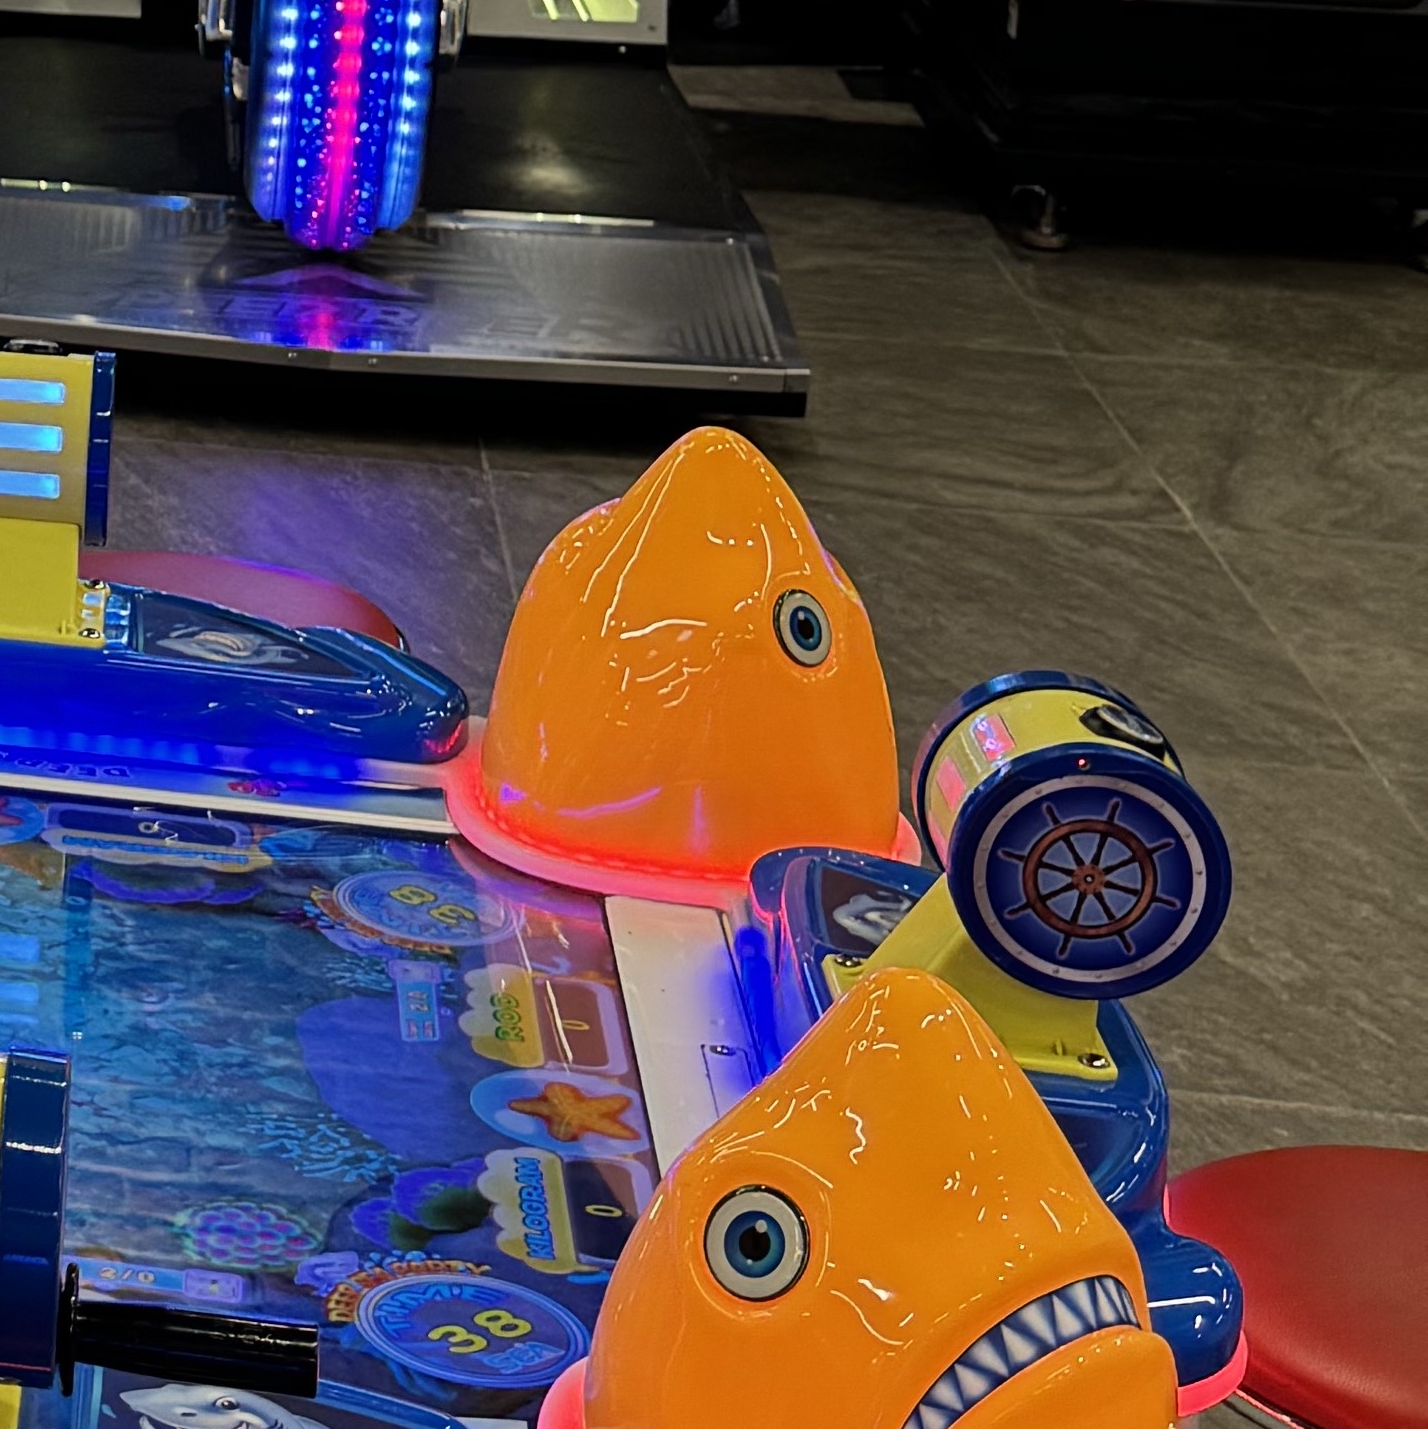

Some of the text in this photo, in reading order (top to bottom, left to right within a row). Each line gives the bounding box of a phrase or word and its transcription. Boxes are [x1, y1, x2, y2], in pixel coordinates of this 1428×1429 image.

[489, 992, 525, 1043] ROD
[515, 1157, 555, 1260] KILOGRAM
[427, 1309, 532, 1354] 38
